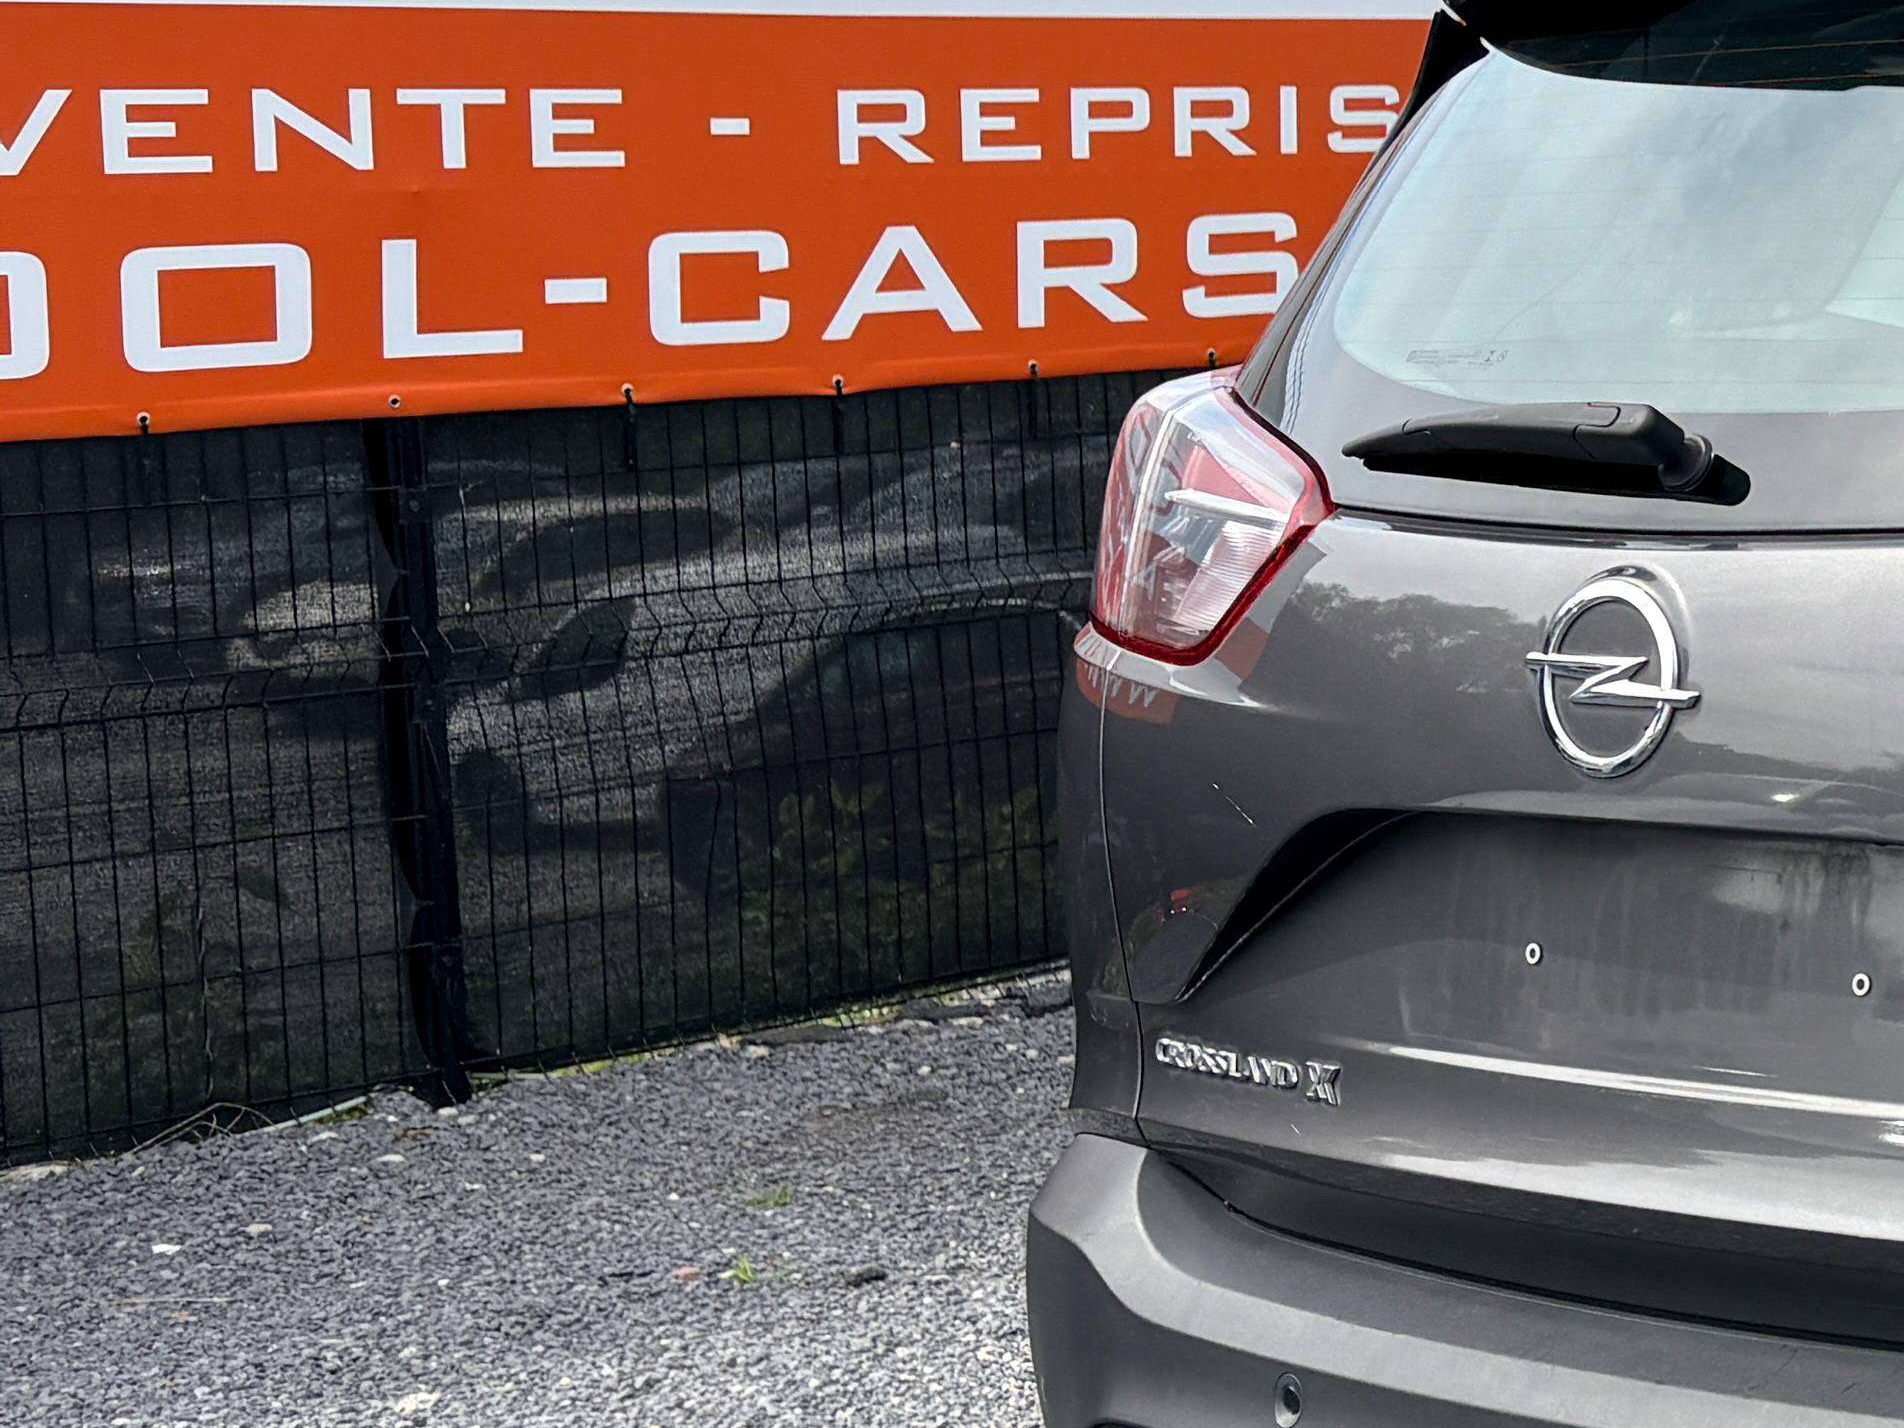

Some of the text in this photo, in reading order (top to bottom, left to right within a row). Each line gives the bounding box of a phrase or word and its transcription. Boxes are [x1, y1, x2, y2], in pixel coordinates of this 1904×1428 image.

[837, 85, 1400, 164] REPRIS
[0, 212, 1300, 380] OL-CARS
[1154, 1037, 1342, 1107] CROSSLAND X
